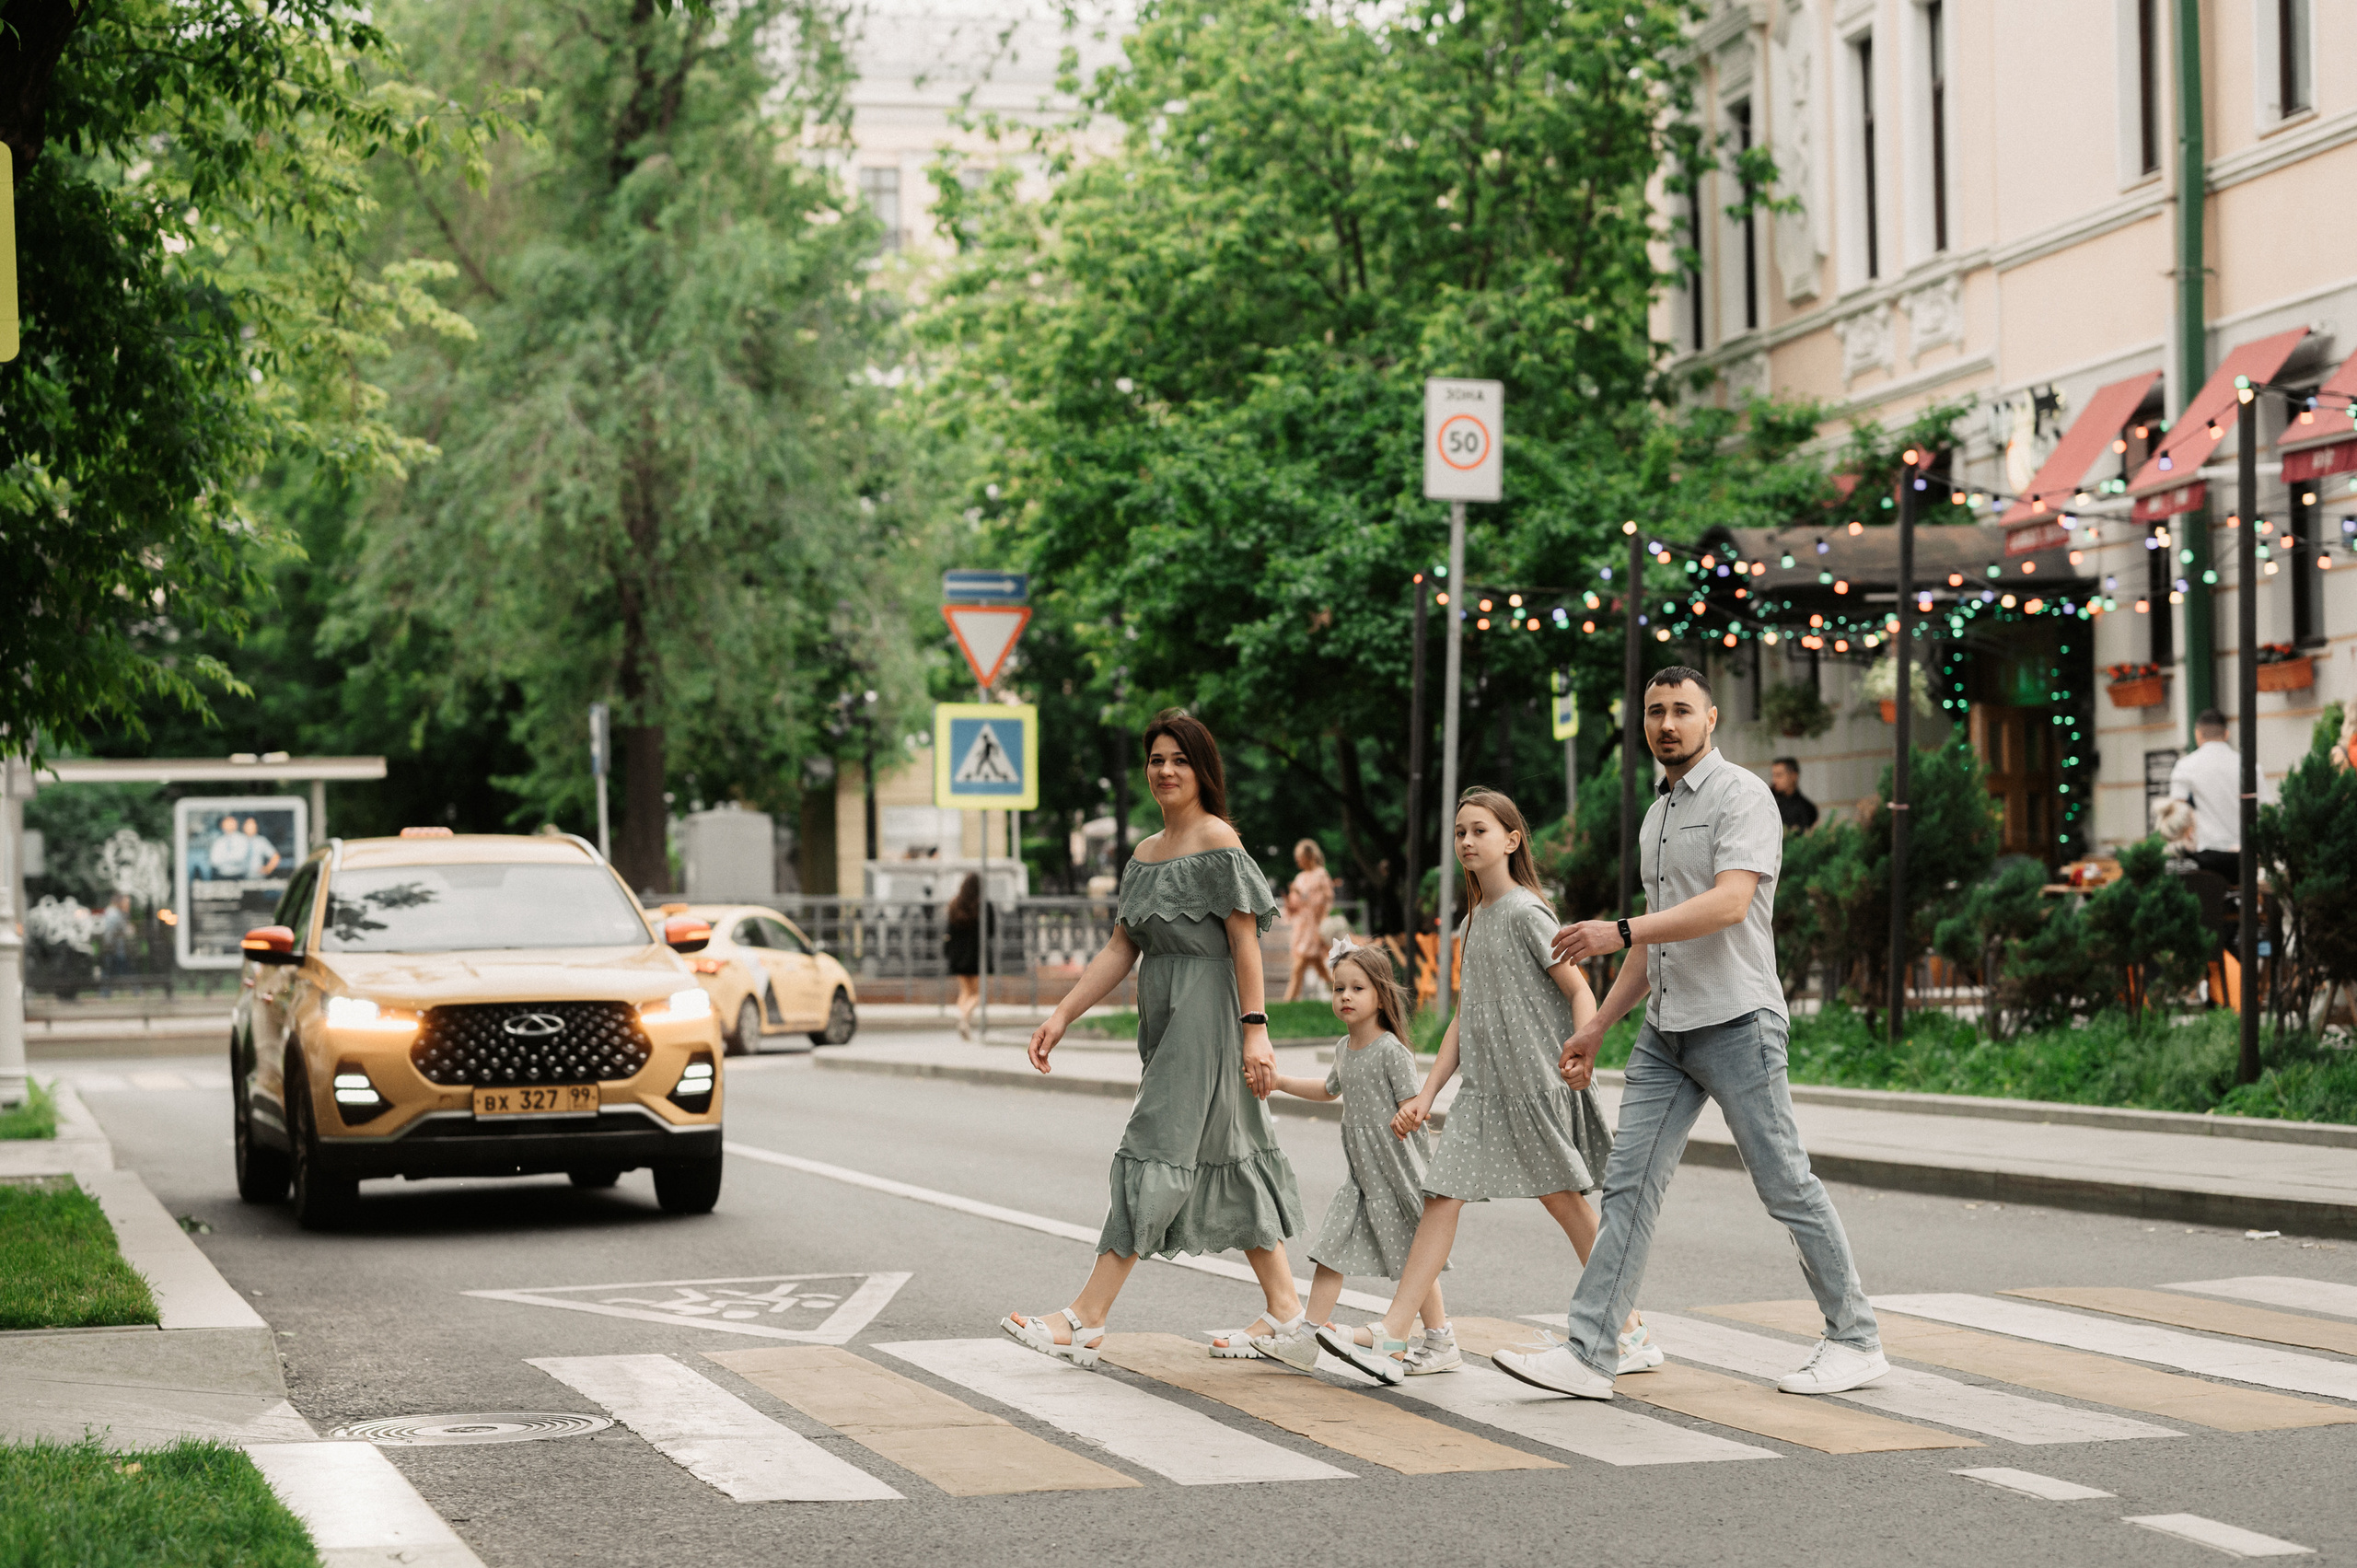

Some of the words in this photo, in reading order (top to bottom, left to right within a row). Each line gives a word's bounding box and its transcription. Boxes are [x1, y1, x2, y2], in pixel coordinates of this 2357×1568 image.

[1449, 430, 1479, 453] 50
[519, 1089, 558, 1109] 327
[570, 1087, 590, 1102] 99
